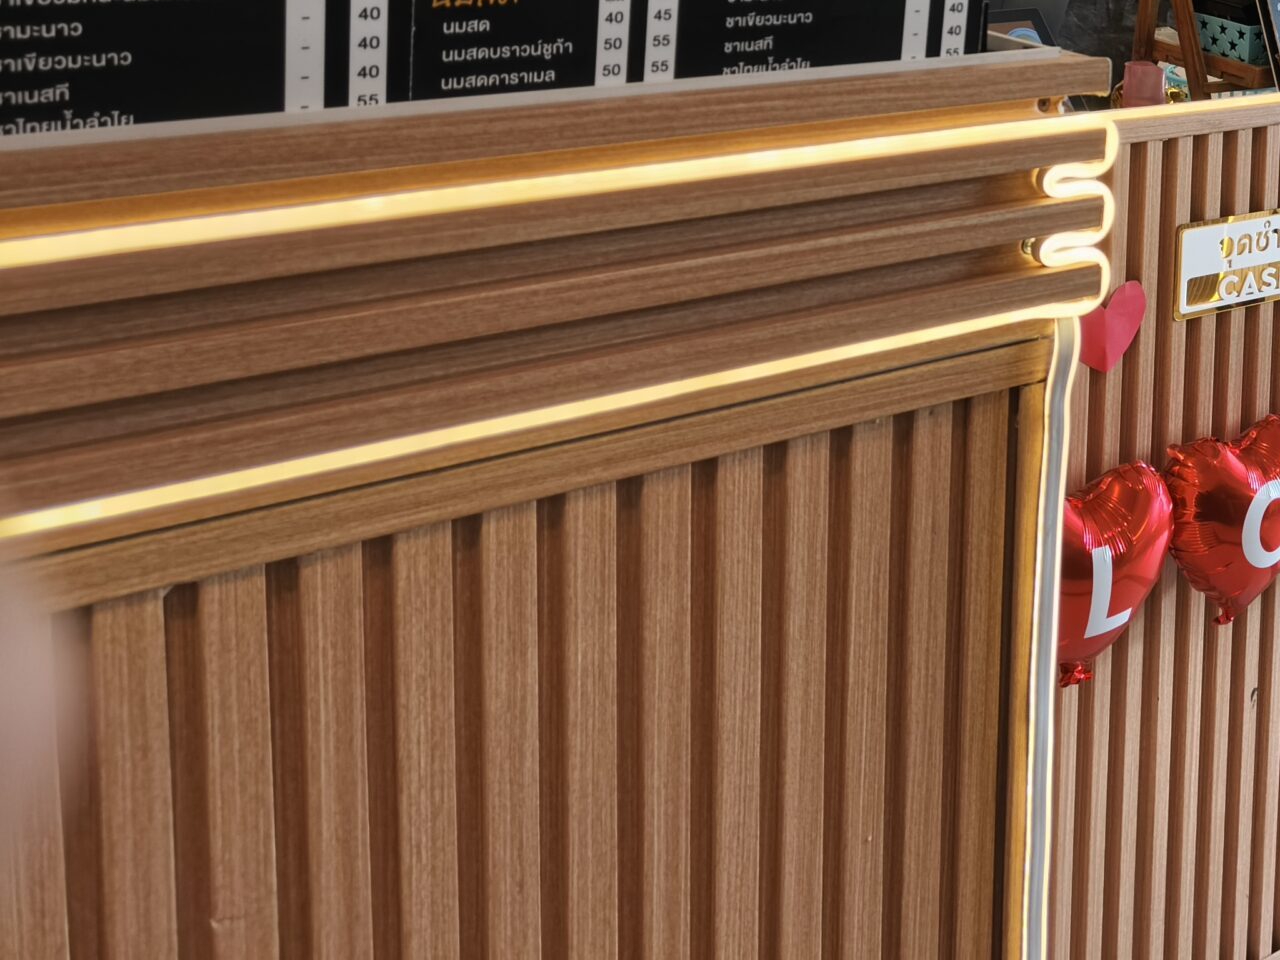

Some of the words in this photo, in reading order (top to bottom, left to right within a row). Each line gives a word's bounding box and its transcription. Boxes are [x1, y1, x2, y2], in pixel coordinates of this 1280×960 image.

[358, 7, 380, 20] 40
[949, 2, 963, 13] 40
[605, 12, 623, 23] 40
[654, 9, 671, 20] 45
[726, 12, 812, 28] ชาเขียวมะนาว
[443, 20, 490, 34] นมสด
[947, 25, 961, 35] 40
[358, 36, 380, 49] 40
[604, 38, 622, 50] 50
[653, 35, 670, 47] 55
[442, 39, 572, 62] นมสดบราวน์ชูก้า
[357, 65, 379, 78] 40
[603, 64, 621, 76] 50
[651, 60, 668, 72] 55
[441, 70, 555, 89] นมสดคาราเมล
